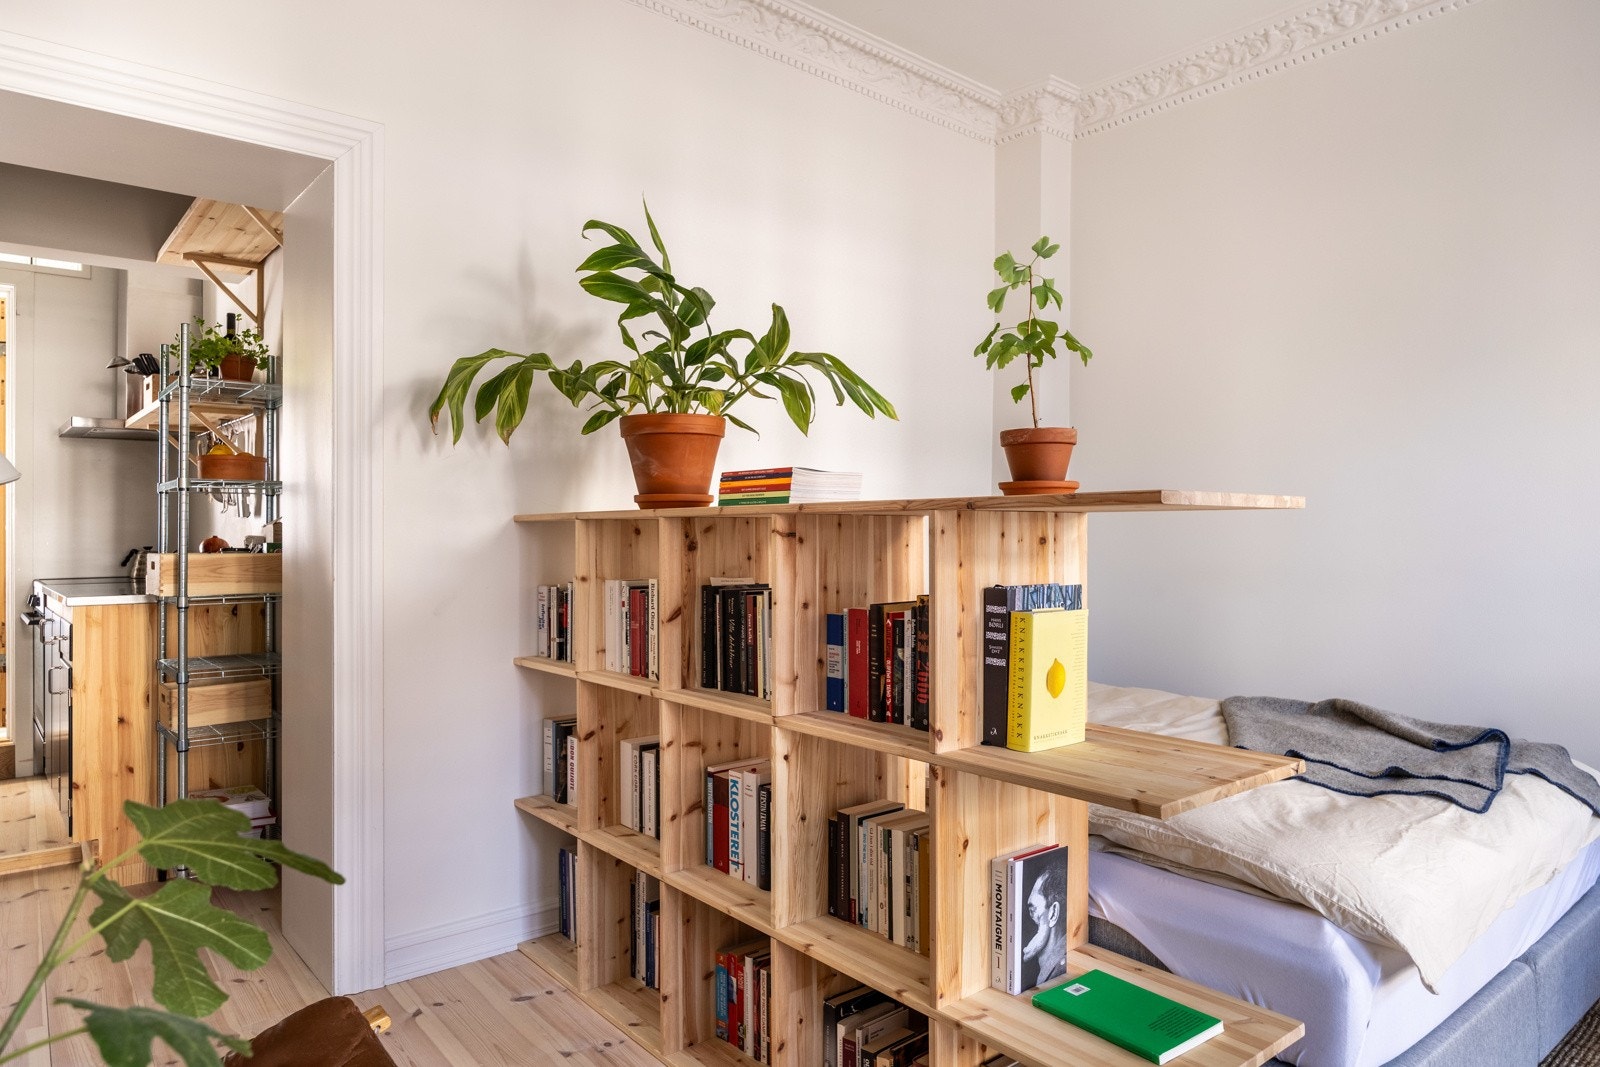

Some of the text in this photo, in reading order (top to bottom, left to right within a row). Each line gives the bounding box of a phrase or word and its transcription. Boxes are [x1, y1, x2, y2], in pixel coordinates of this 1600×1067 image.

[917, 660, 929, 704] 2666
[1016, 617, 1026, 738] KNAKKETIKNAKK
[730, 779, 739, 869] KLOSTERET
